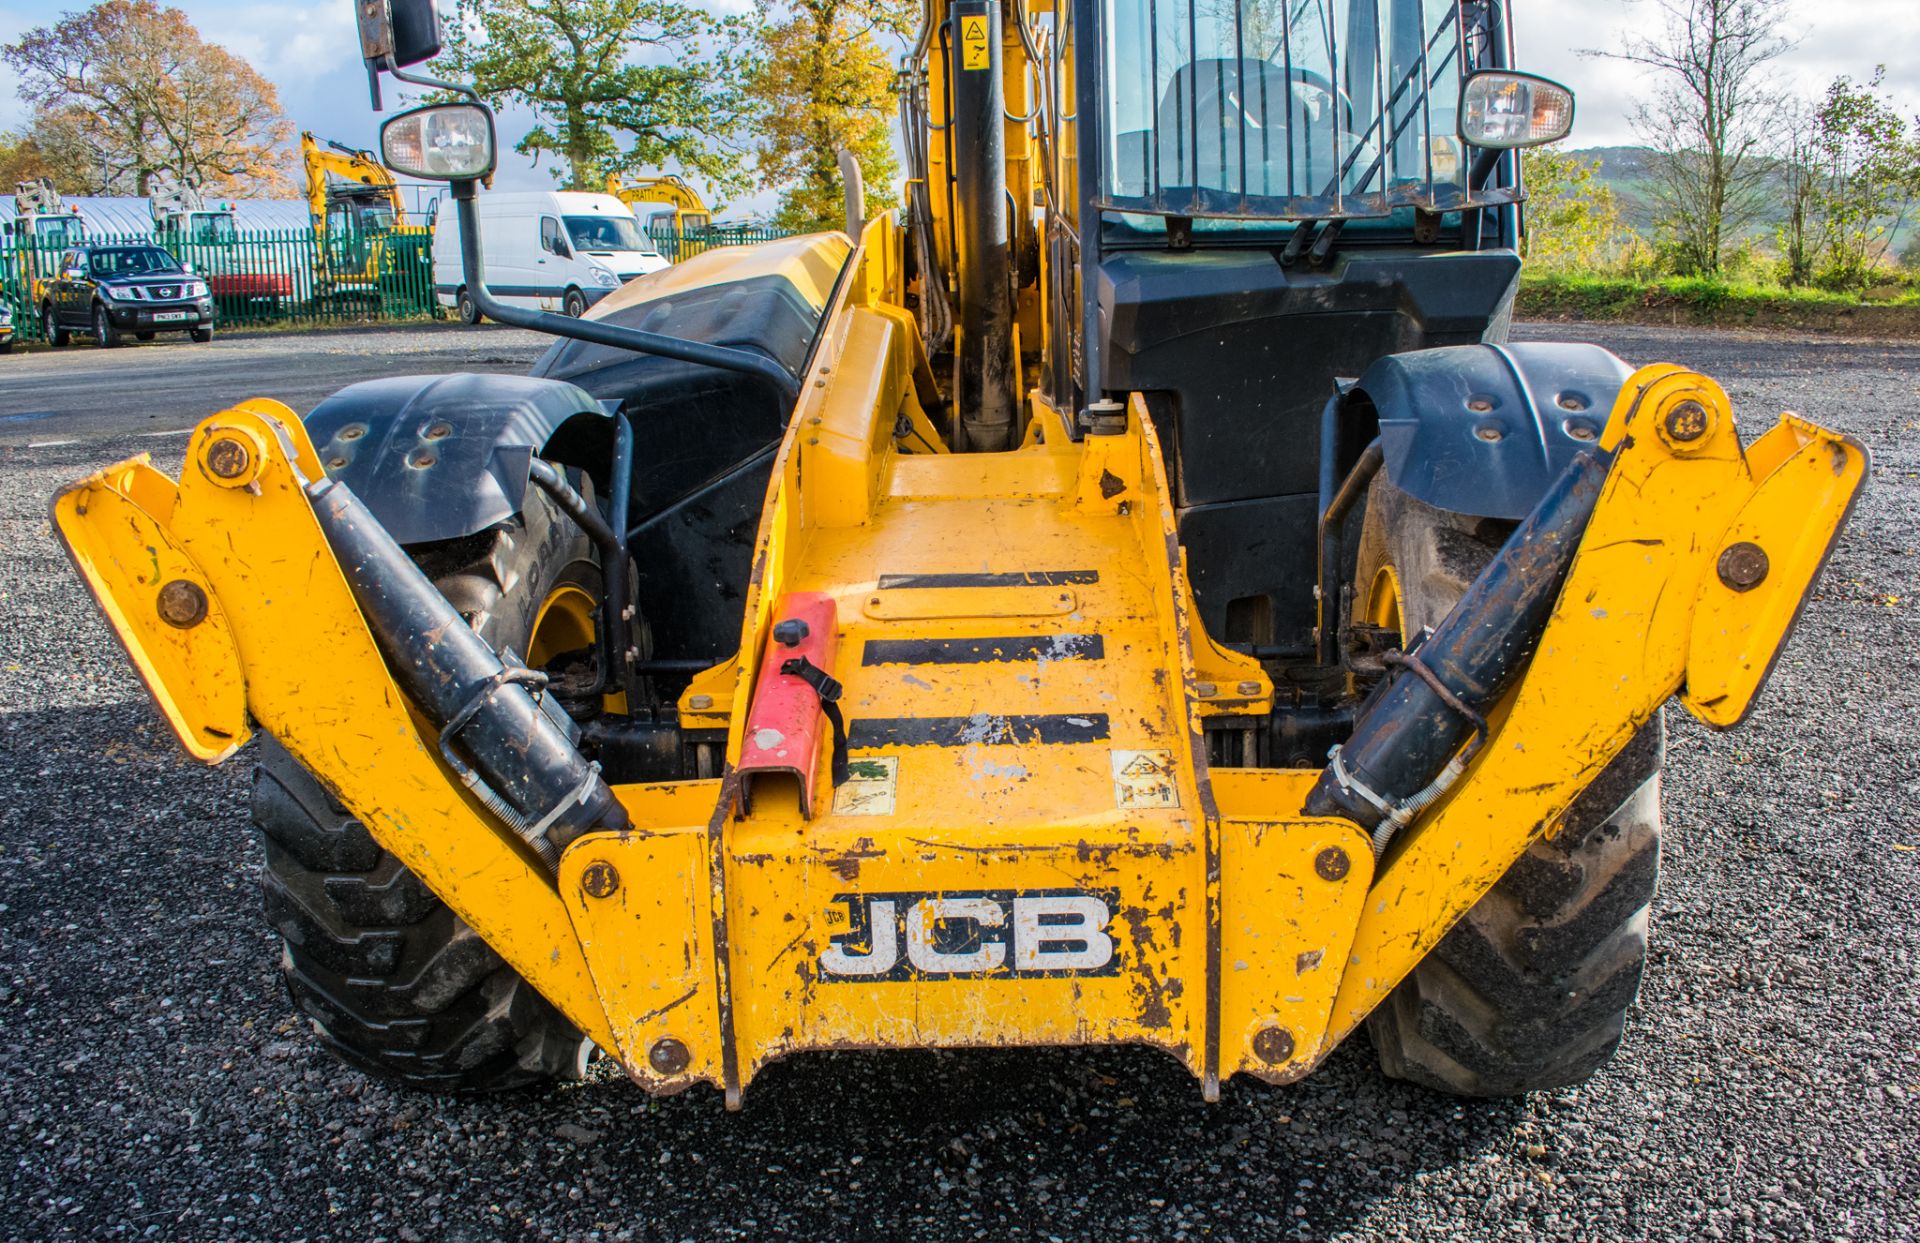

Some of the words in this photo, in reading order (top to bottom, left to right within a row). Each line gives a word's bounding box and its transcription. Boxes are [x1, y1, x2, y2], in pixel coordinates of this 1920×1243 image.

[631, 188, 655, 200] PRATTY
[825, 909, 845, 925] JCB
[820, 896, 1113, 975] JCB
